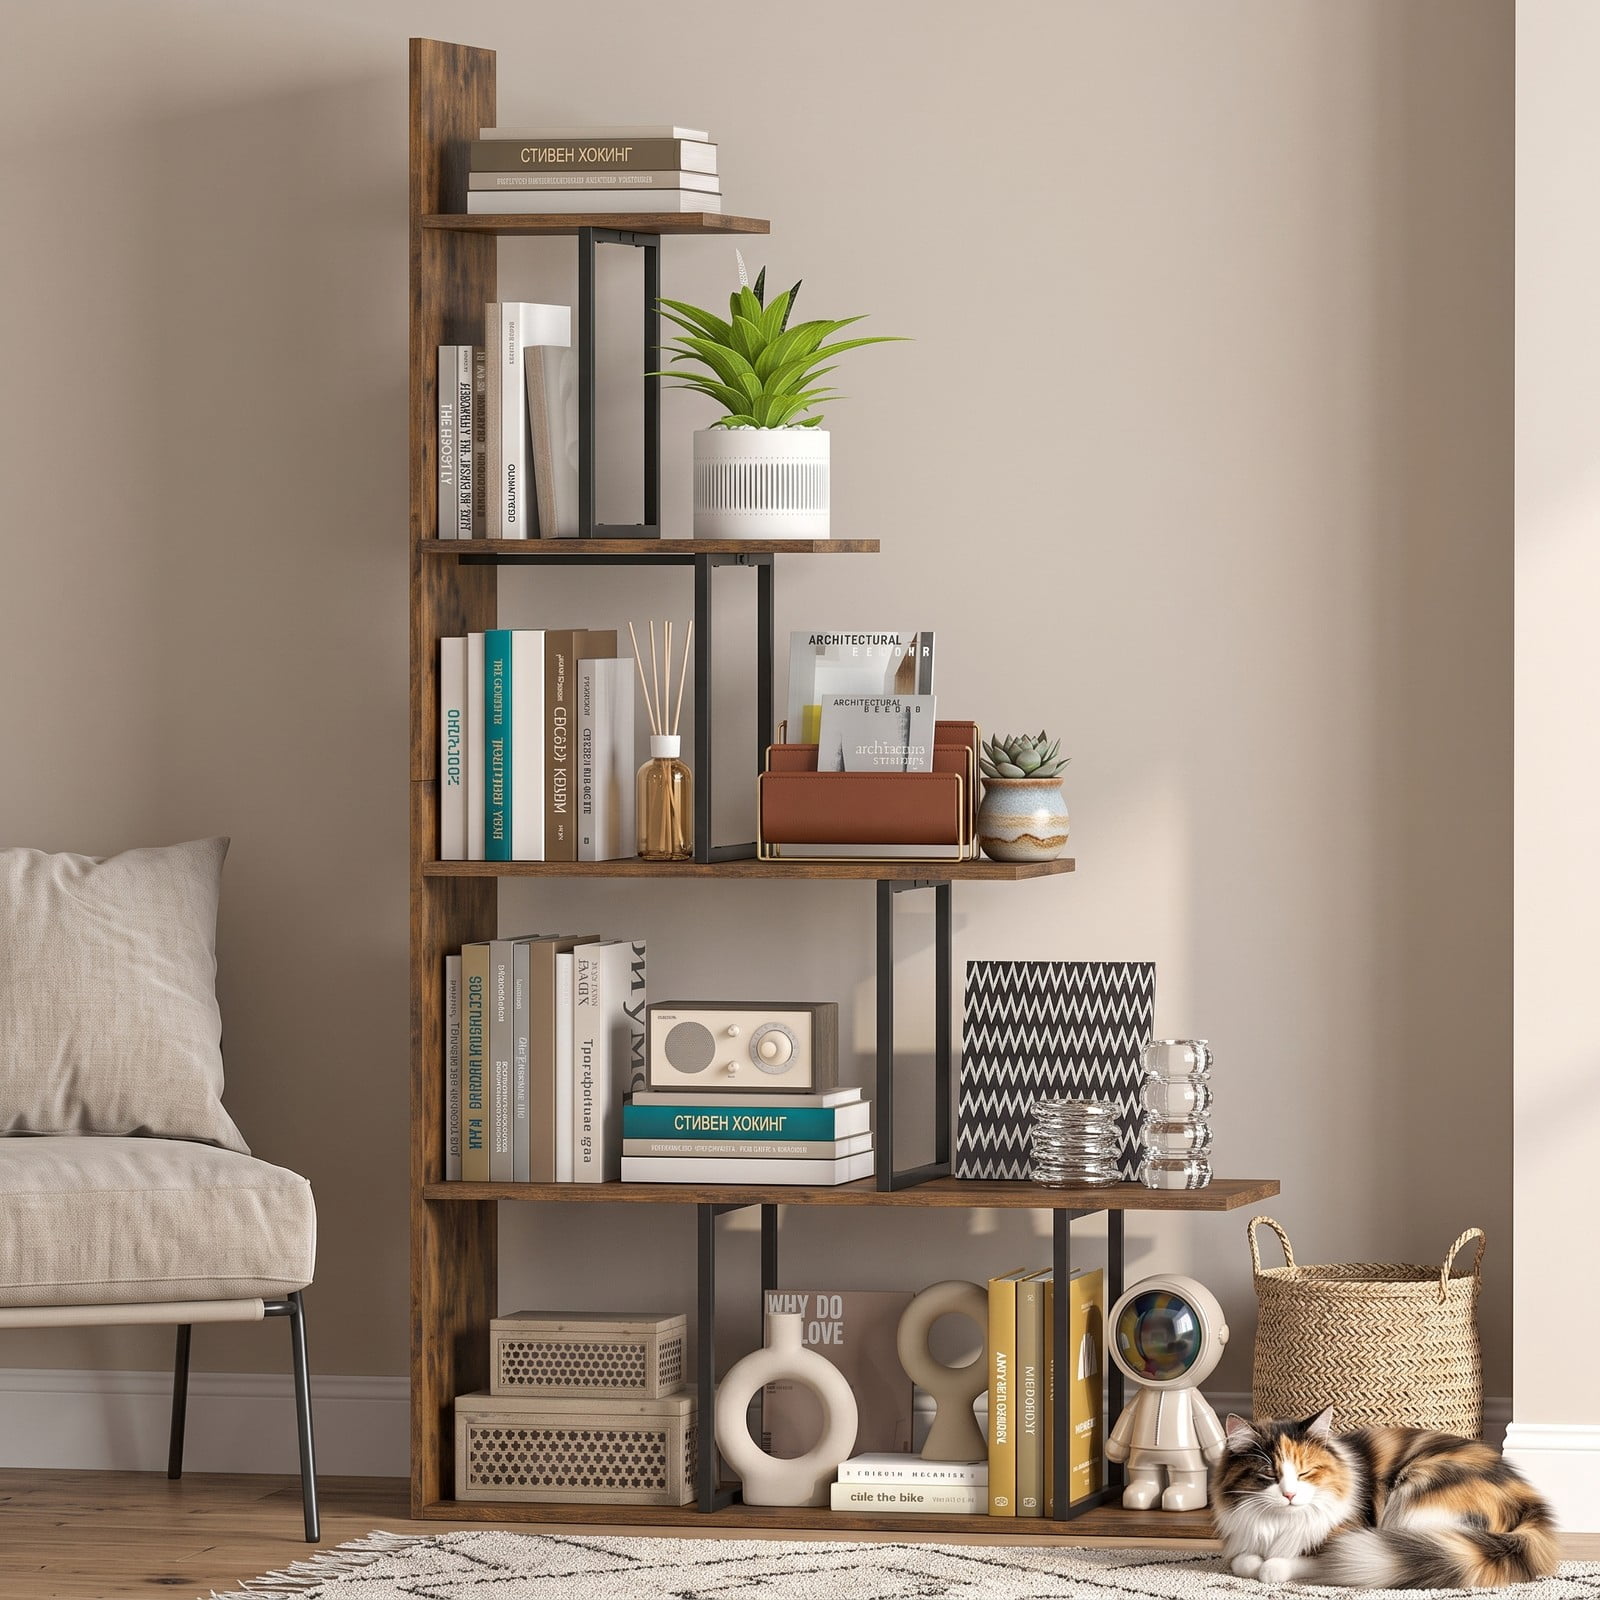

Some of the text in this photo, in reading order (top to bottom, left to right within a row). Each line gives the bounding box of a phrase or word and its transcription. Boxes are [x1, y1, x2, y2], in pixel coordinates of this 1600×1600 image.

[520, 147, 633, 164] СТИВЕН ХОКИНГ
[440, 403, 453, 427] THE
[808, 634, 902, 646] ARCHITECTURAL
[674, 1114, 787, 1132] СТИВЕН ХОКИНГ
[768, 1294, 843, 1320] WHY DO
[877, 1492, 897, 1503] the
[899, 1492, 925, 1503] bike
